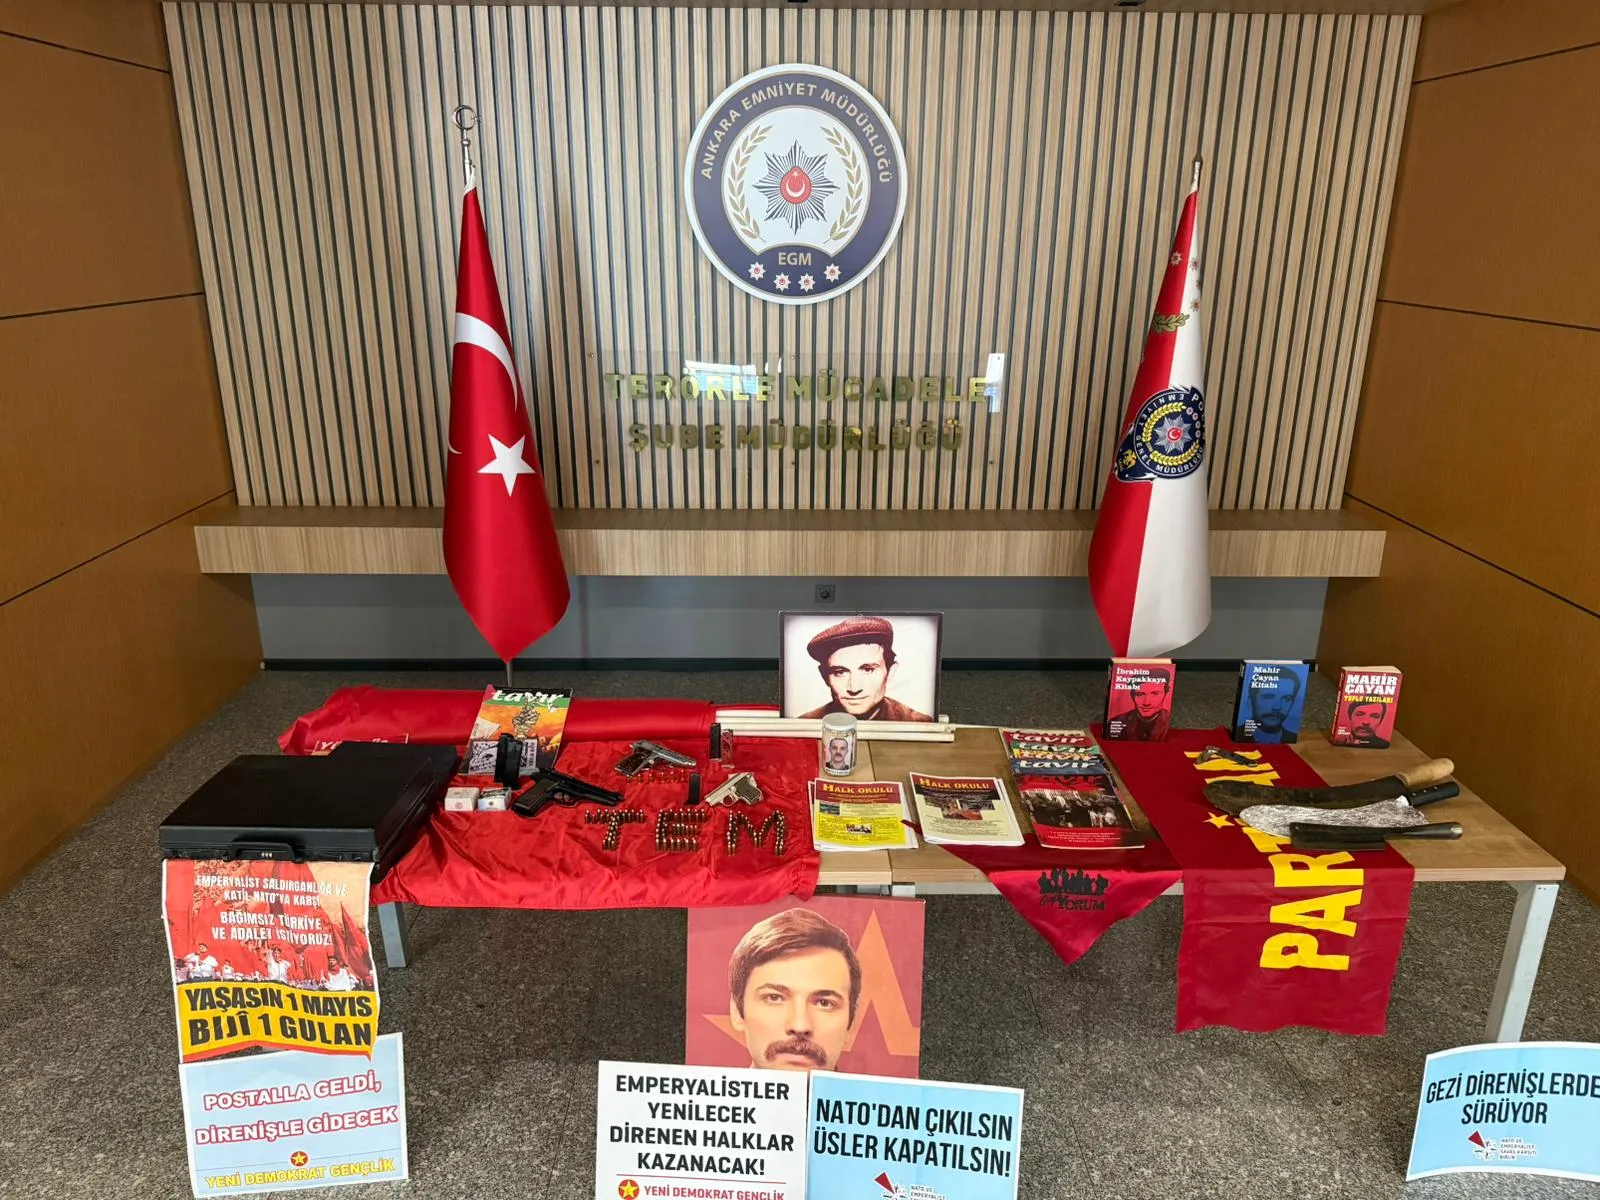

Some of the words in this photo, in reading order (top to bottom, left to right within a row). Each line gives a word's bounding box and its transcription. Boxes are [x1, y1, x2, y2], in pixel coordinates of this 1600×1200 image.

[701, 108, 741, 180] ANKARA
[741, 81, 818, 112] EMNİYET
[821, 88, 891, 183] MÜDÜRLÜĞÜ
[778, 252, 812, 266] EGM
[605, 368, 775, 402] TERÖRLE
[788, 368, 988, 402] MÜCADELE
[628, 424, 725, 453] ŞUBE
[736, 418, 963, 451] MÜDÜRLÜĞÜ
[1115, 676, 1167, 684] Kaypakkaya
[1251, 674, 1279, 682] Çayan
[1253, 666, 1280, 674] Mahir
[1346, 673, 1398, 686] MAHİR
[1344, 684, 1396, 695] ÇAYAN
[822, 783, 854, 794] HALK
[919, 778, 951, 789] HALK
[195, 875, 260, 888] EMPERYALİST
[262, 878, 332, 895] SALDIRGANLIĞA
[335, 883, 347, 897] VE
[224, 888, 248, 901] KATİL
[293, 894, 321, 907] KARŞI
[220, 910, 275, 926] BAĞIMSIZ
[277, 913, 322, 931] TÜRKİYE
[211, 927, 226, 940] VE
[230, 927, 272, 940] ADALET
[275, 926, 333, 946] İSTİYORUZ!
[186, 985, 284, 1013] YAŞASIN
[286, 992, 297, 1011] 1
[303, 993, 373, 1017] MAYIS
[257, 1013, 272, 1036] 1
[279, 1015, 372, 1046] GULAN
[203, 1084, 310, 1111] POSTALLA
[314, 1070, 382, 1097] GELDİ,
[616, 1074, 790, 1101] EMPERYALİSTLER
[1426, 1073, 1463, 1104] GEZİ
[1465, 1068, 1600, 1099] DİRENİŞLERDE
[647, 1100, 757, 1124] YENİLECEK
[816, 1098, 920, 1131] NATO'DAN
[925, 1107, 1013, 1141] ÇIKILSIN
[1461, 1098, 1548, 1125] SÜRÜYOR
[195, 1119, 304, 1145] DİRENİŞLE
[307, 1105, 399, 1133] GİDECEK
[610, 1122, 697, 1146] DİRENEN
[702, 1130, 794, 1152] HALKLAR
[637, 1152, 765, 1176] KAZANACAK!
[814, 1126, 878, 1160] ÜSLER
[884, 1136, 1011, 1178] KAPATILSIN!
[205, 1173, 242, 1189] YENİ
[245, 1167, 325, 1185] DEMOKRAT
[330, 1157, 394, 1178] GENÇLİK
[644, 1184, 670, 1197] YENİ
[672, 1186, 734, 1200] DEMOKRAT
